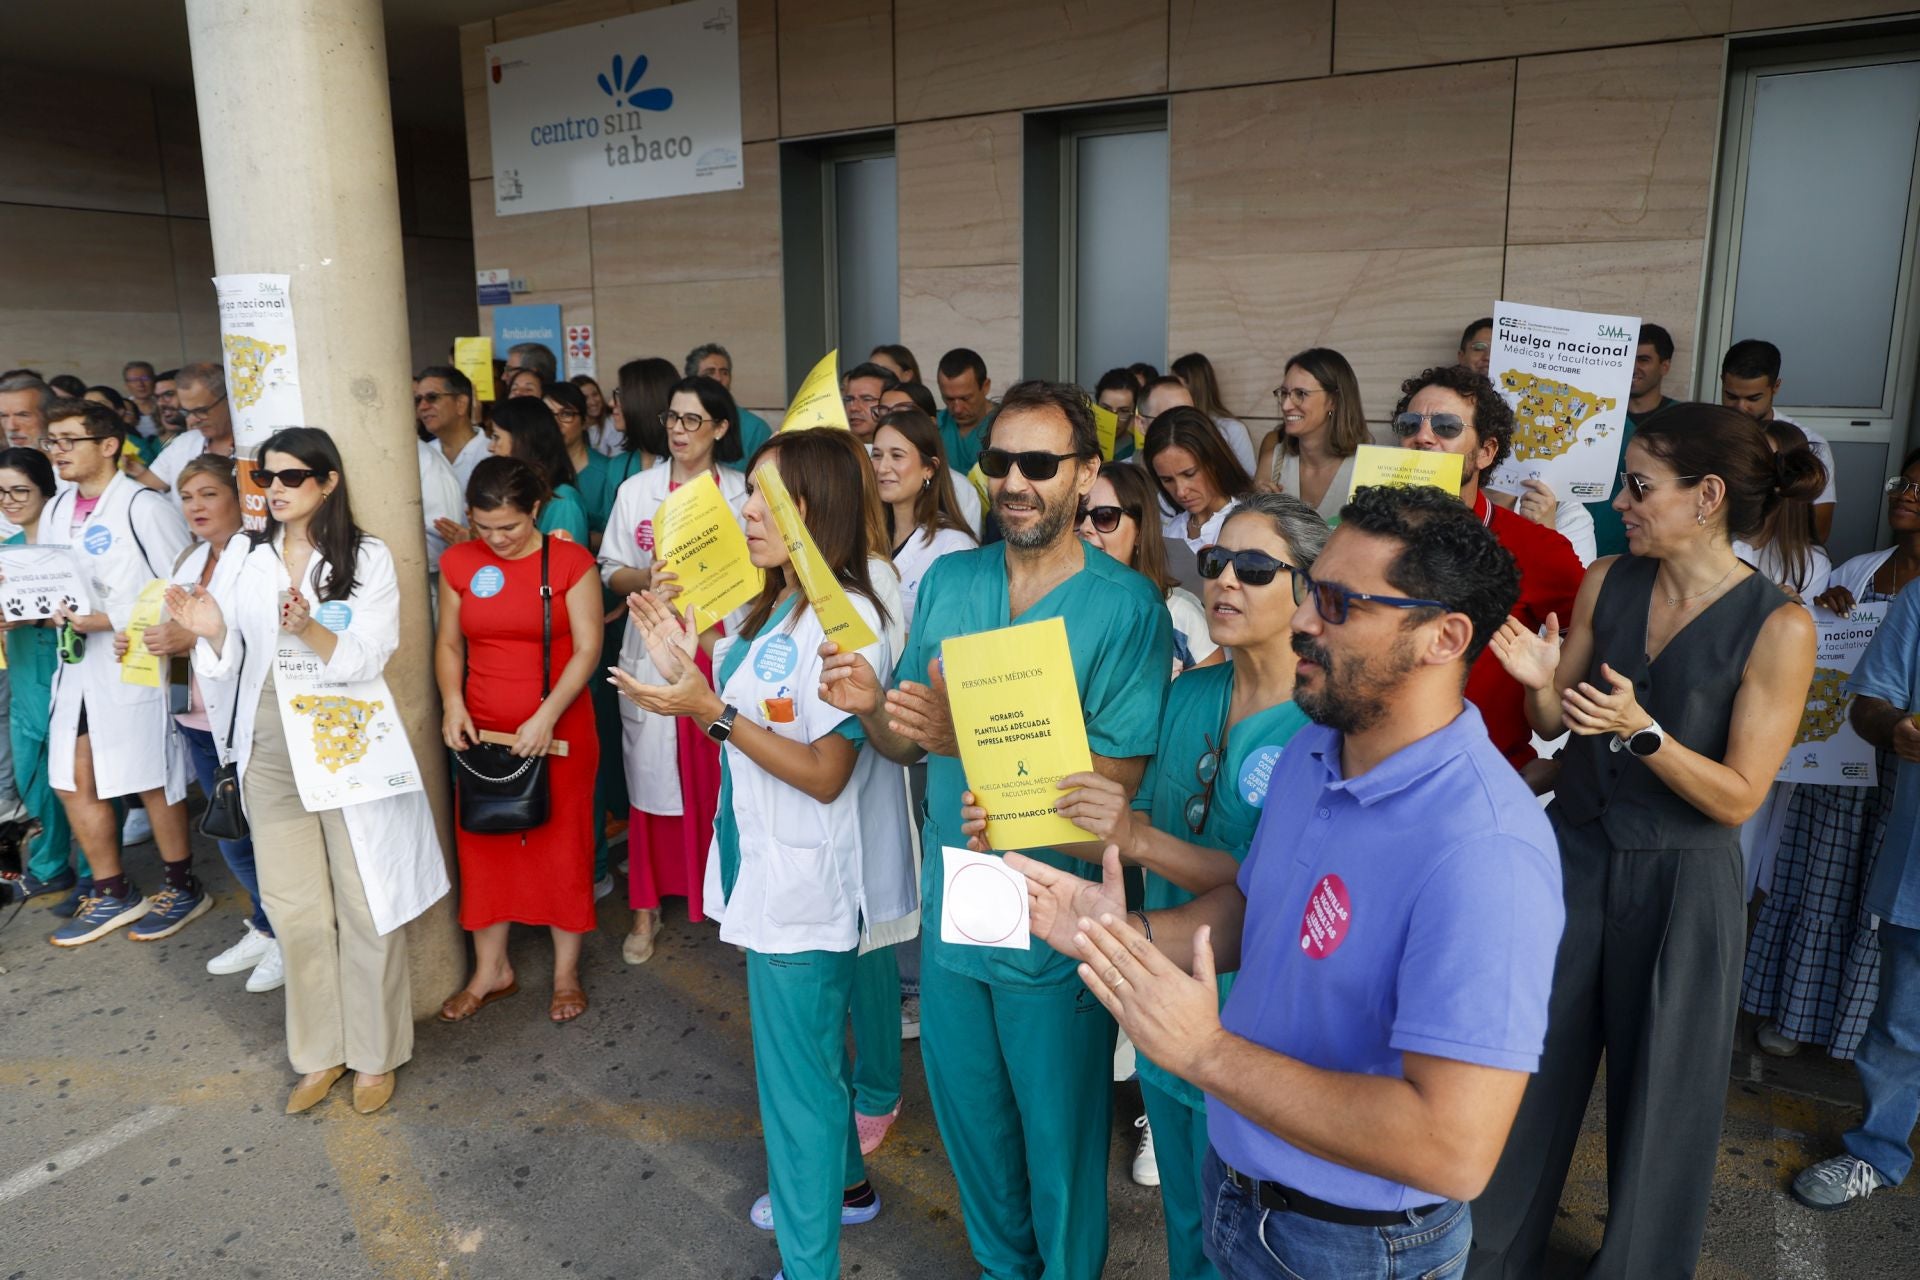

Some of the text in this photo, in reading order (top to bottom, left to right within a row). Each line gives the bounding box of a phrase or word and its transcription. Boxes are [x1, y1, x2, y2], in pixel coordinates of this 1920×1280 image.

[531, 110, 642, 146] centro sin
[604, 135, 692, 168] tabaco
[237, 297, 285, 308] nacional
[502, 327, 553, 339] Ambulancias
[1597, 324, 1627, 339] SMA
[1499, 329, 1551, 349] Huelga
[1558, 341, 1628, 357] nacional
[1503, 344, 1623, 368] Médicos y facultativos
[1548, 364, 1581, 375] OCTUBRE
[664, 524, 719, 560] TOLERANCIA CERO
[681, 535, 718, 561] AGRESIONES
[1852, 611, 1876, 622] SMA
[832, 621, 849, 632] PROPIO
[1825, 641, 1869, 650] facultativo
[961, 667, 1043, 689] PERSONAS Y MÉDICOS
[990, 710, 1024, 722] HORARIOS
[974, 718, 1051, 735] PLANTILLAS ADECUADAS
[977, 729, 1052, 747] EMPRESA RESPONSABLE
[1254, 767, 1270, 780] PERO
[979, 783, 1001, 791] HUELGA
[1001, 781, 1032, 790] NACIONAL
[1001, 787, 1047, 798] FACULTATIVOS
[987, 807, 1058, 821] ESTATUTO MARCO PR
[1323, 878, 1348, 920] PLANTILLAS
[1313, 895, 1337, 940] CONSULTAS
